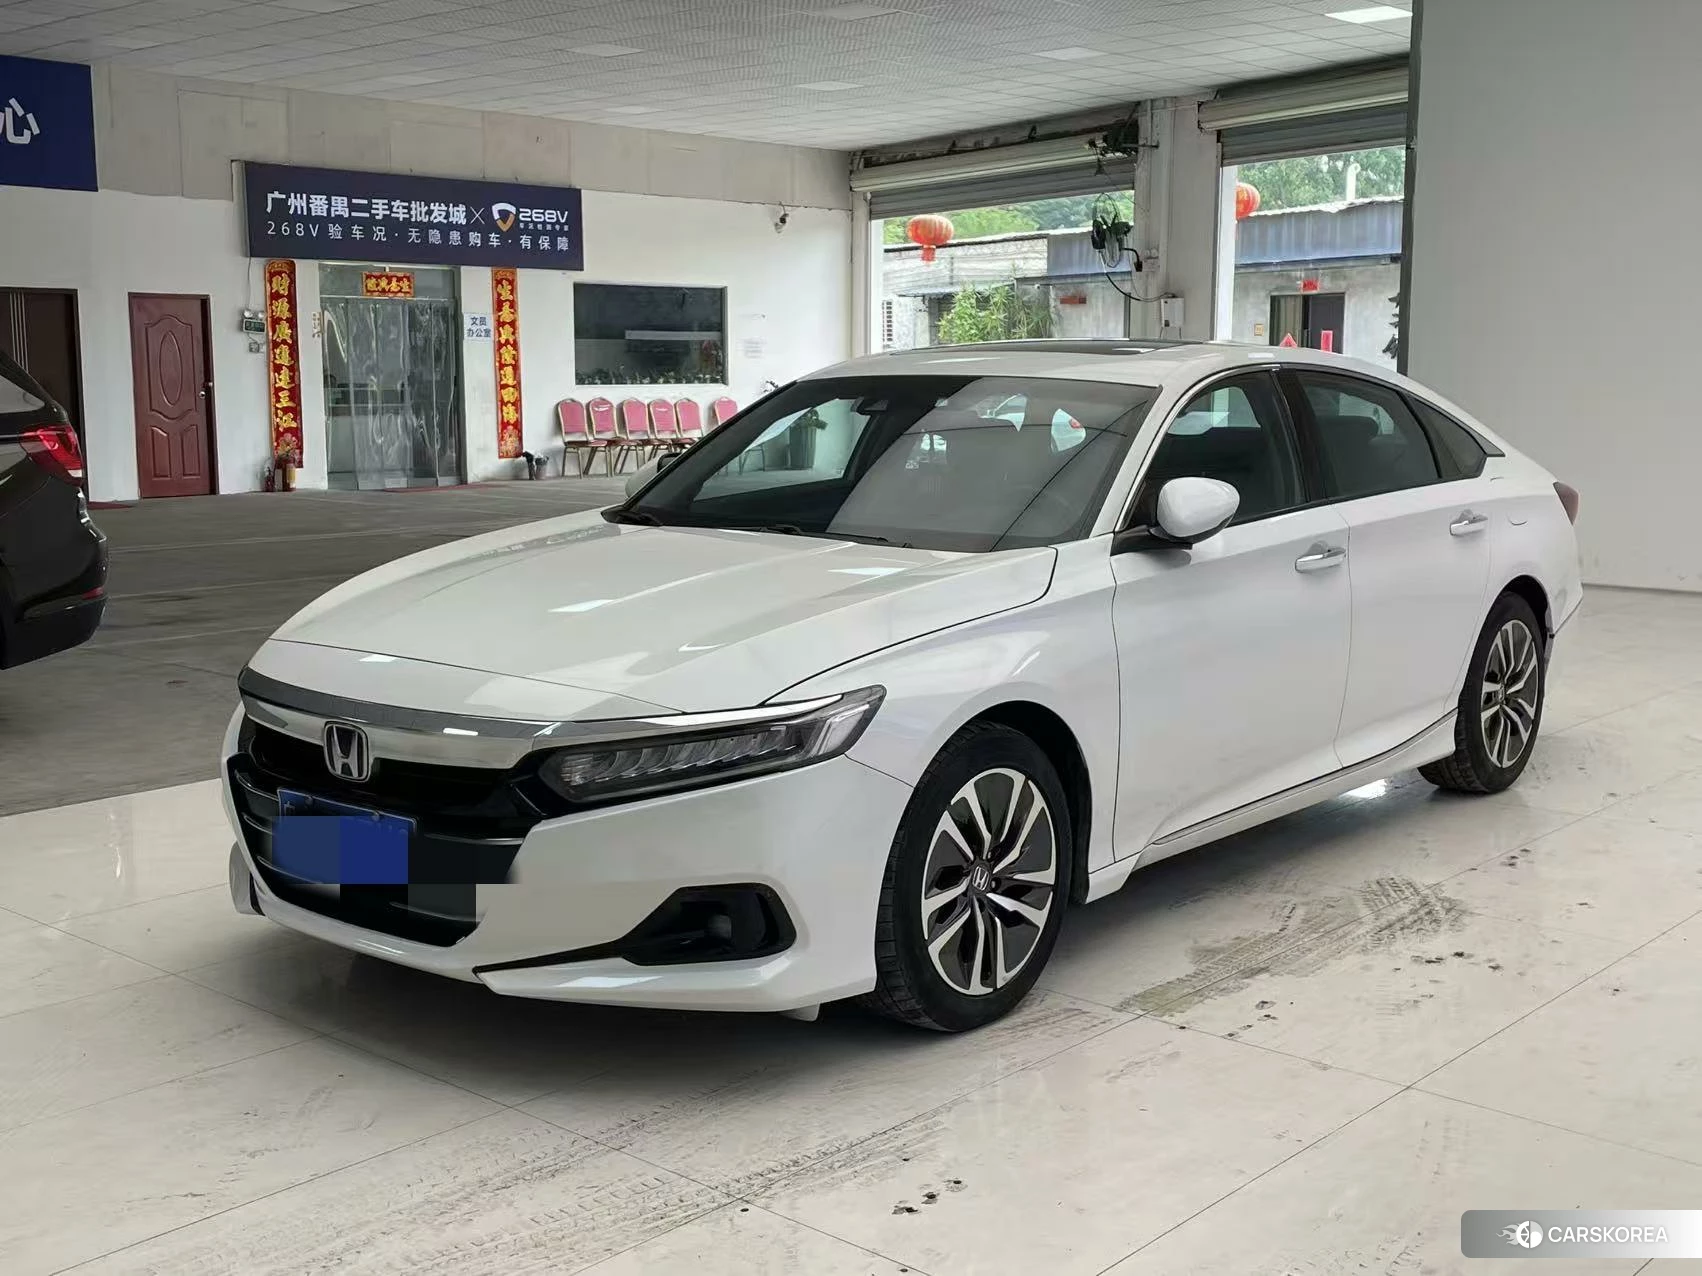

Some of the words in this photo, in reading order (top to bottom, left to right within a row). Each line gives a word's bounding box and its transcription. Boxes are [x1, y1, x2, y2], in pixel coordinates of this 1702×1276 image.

[0, 97, 40, 144] 心
[265, 191, 467, 226] 广州番禺二手车批发城
[519, 208, 568, 223] 268V
[470, 316, 487, 326] 文员
[466, 328, 492, 338] 办公室
